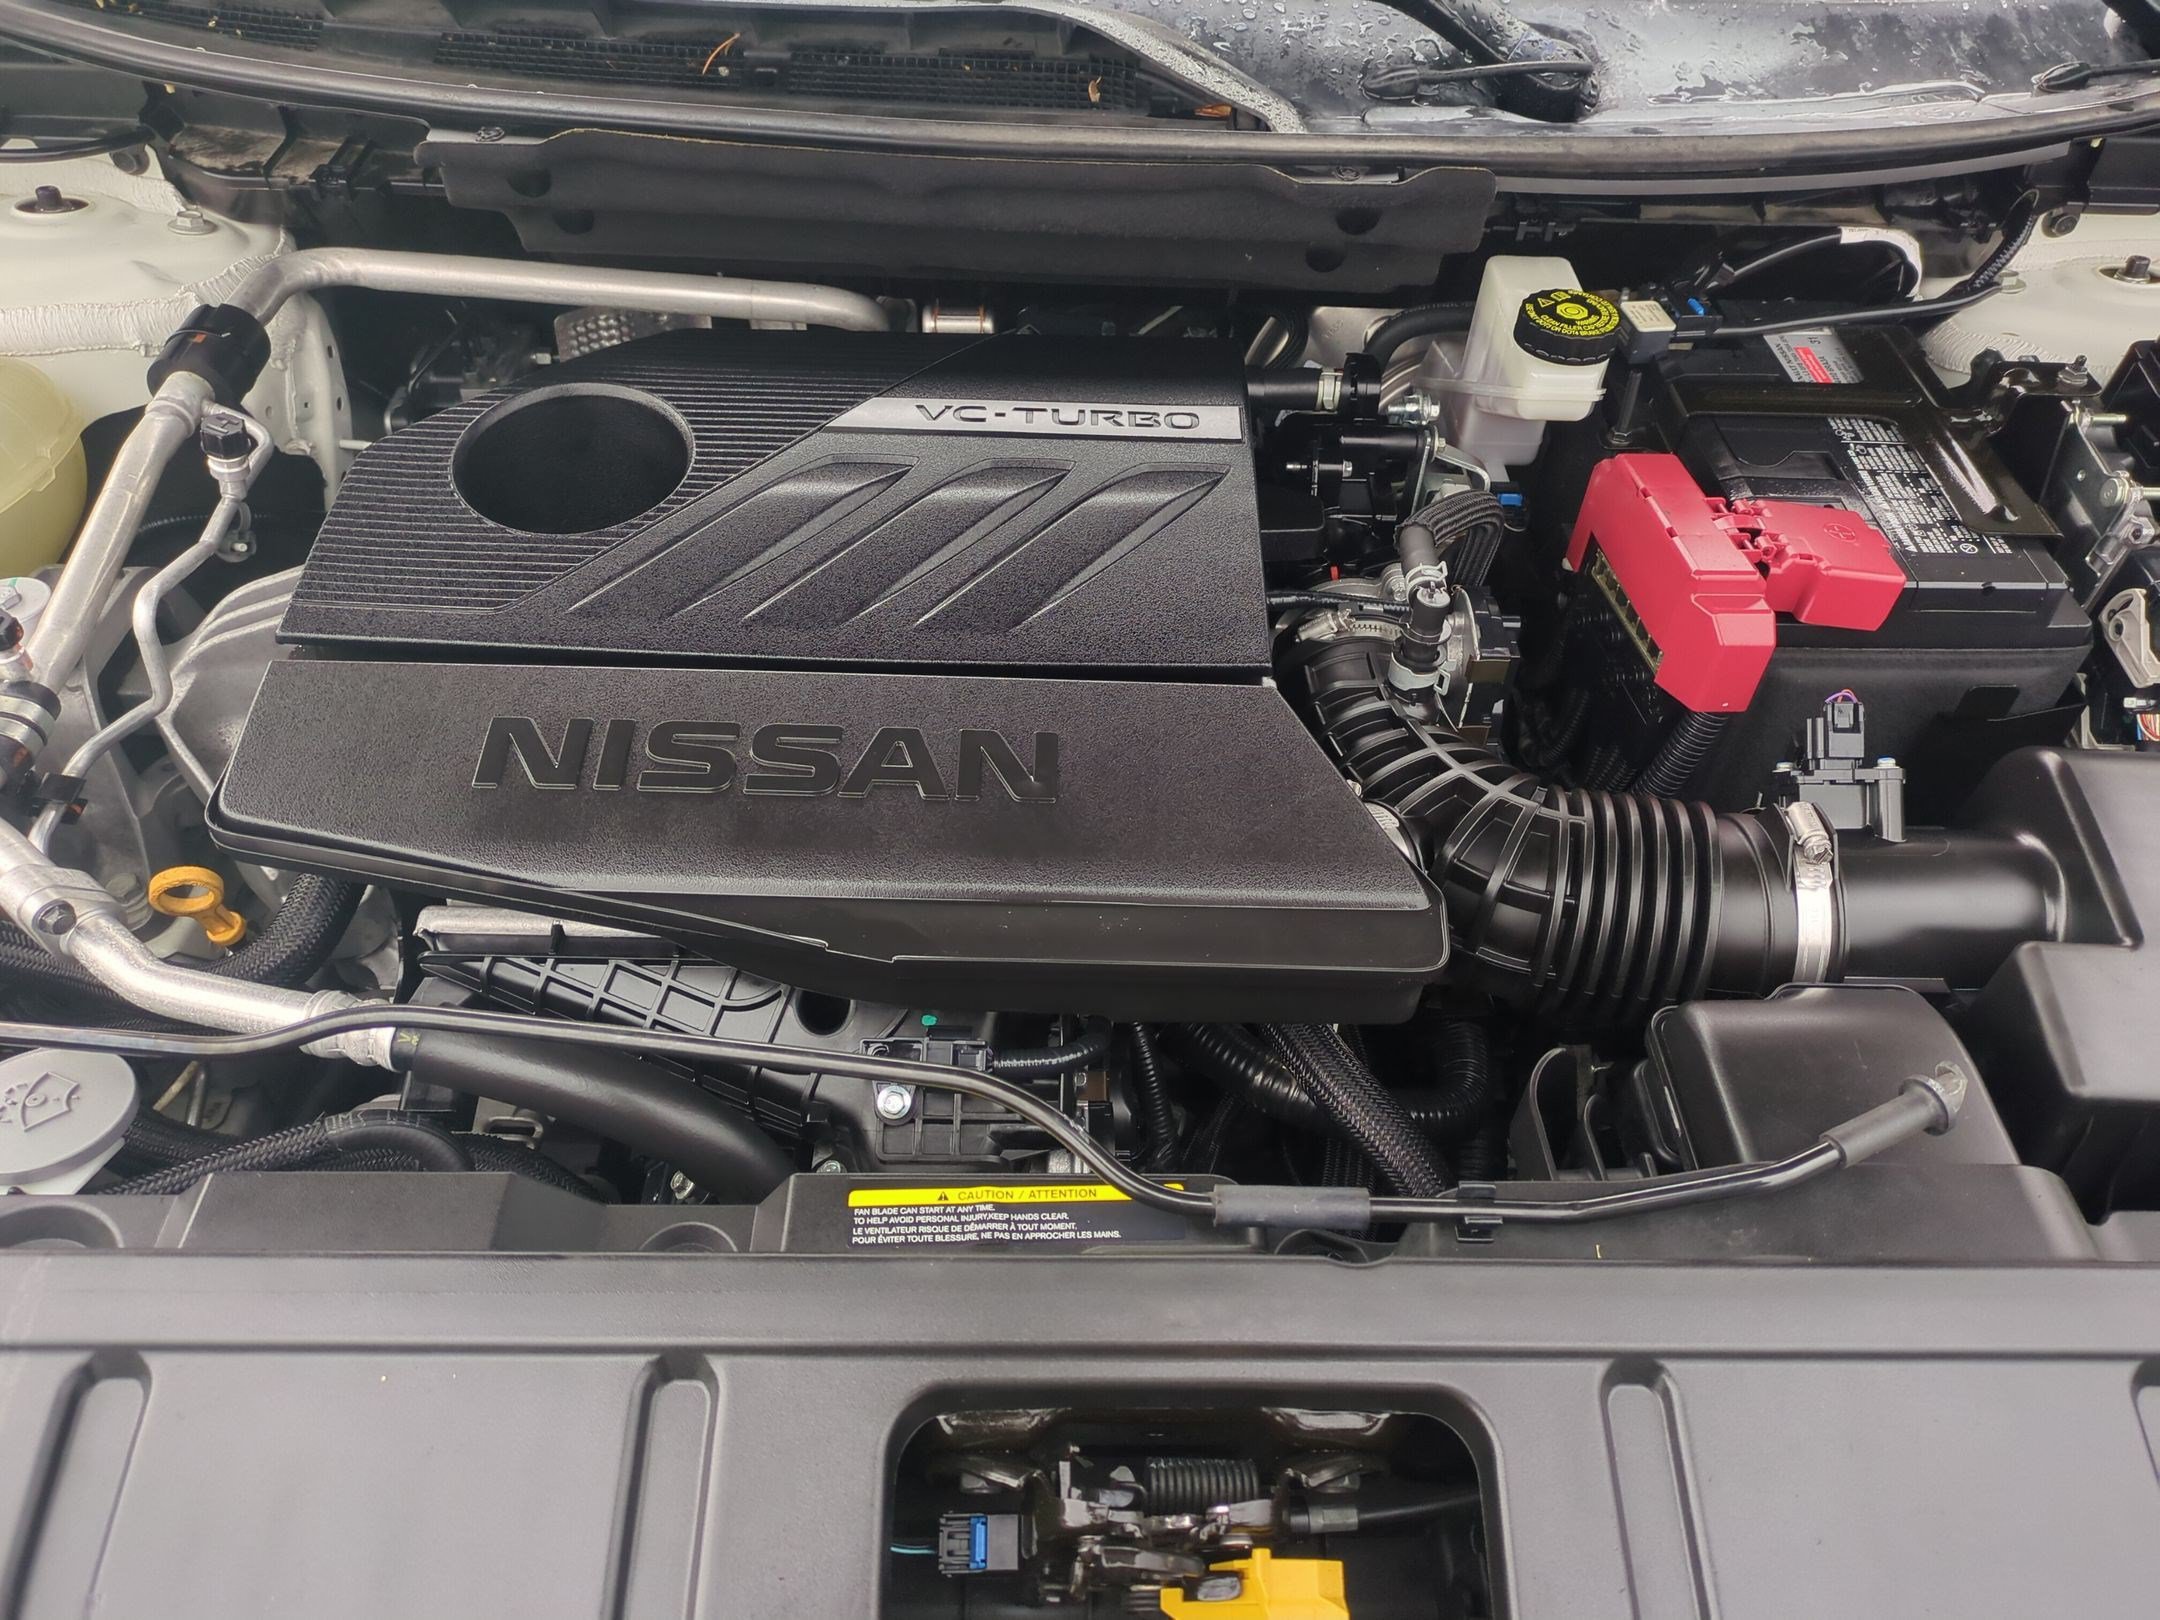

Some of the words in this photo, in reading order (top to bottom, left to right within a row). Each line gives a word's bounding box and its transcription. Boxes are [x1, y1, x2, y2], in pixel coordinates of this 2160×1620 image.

[914, 404, 1200, 429] VC-TURBO
[472, 716, 1059, 803] NISSAN
[957, 1189, 1014, 1201] CAUTION
[1028, 1188, 1098, 1200] ATTENTION
[854, 1208, 871, 1216] FAN
[872, 1207, 898, 1216] BLADE
[900, 1206, 918, 1214] CAN
[919, 1206, 944, 1214] START
[956, 1205, 974, 1213] ANY
[975, 1204, 996, 1212] TIME.
[854, 1217, 865, 1225] TO
[866, 1216, 888, 1224] HELP
[889, 1215, 914, 1224] AVOID
[916, 1214, 959, 1223] PERSONAL
[1010, 1212, 1040, 1221] HANDS
[1041, 1212, 1070, 1220] CLEAR.
[852, 1227, 864, 1235] LE
[864, 1226, 917, 1235] VENTILATEUR
[918, 1225, 950, 1234] RISQUE
[951, 1224, 962, 1232] DE
[964, 1222, 1008, 1232] DÉMARRER
[1010, 1222, 1016, 1230] À
[1017, 1222, 1038, 1230] TOUT
[1040, 1222, 1078, 1230] MOMENT.
[852, 1236, 876, 1244] POUR
[878, 1234, 906, 1244] ÉVITER
[906, 1234, 934, 1242] TOUTE
[980, 1232, 993, 1240] NE
[994, 1232, 1010, 1240] PAS
[1012, 1232, 1023, 1240] EN
[1024, 1232, 1076, 1240] APPROCHER
[1077, 1231, 1092, 1239] LES
[1093, 1230, 1122, 1238] MAINS.
